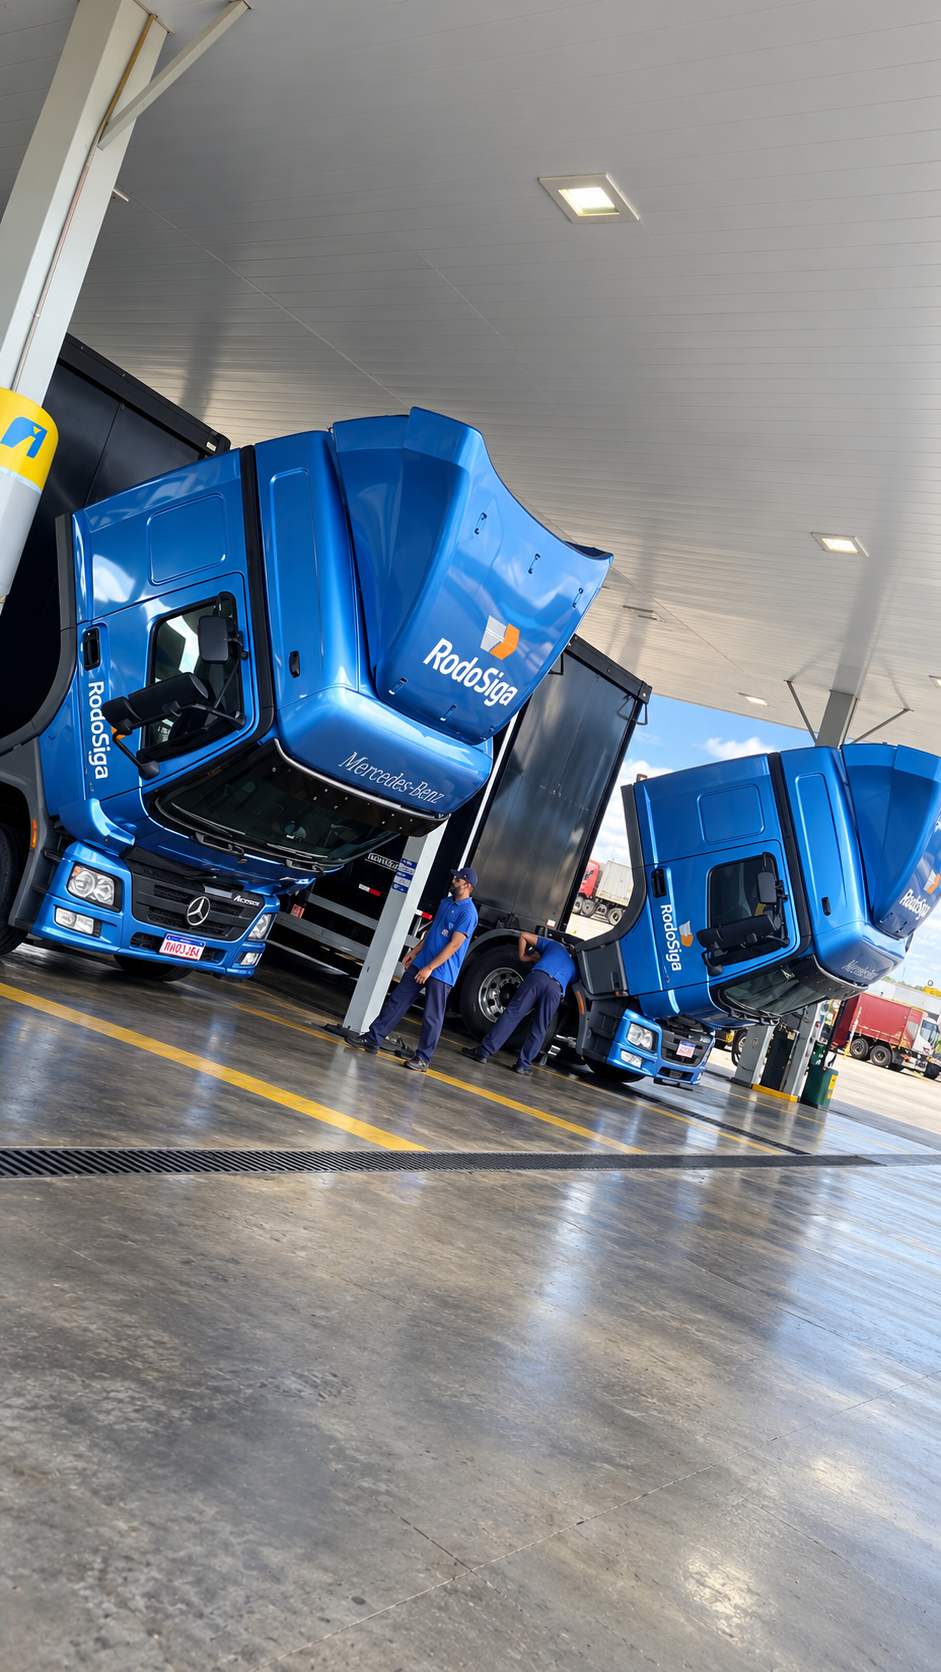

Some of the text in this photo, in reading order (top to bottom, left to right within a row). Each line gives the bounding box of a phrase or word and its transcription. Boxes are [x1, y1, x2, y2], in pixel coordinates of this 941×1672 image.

[423, 637, 518, 707] RodoSiga
[88, 681, 111, 780] RodoSiga
[337, 751, 445, 804] Mercedes-Benz
[660, 904, 683, 972] RodoSiga
